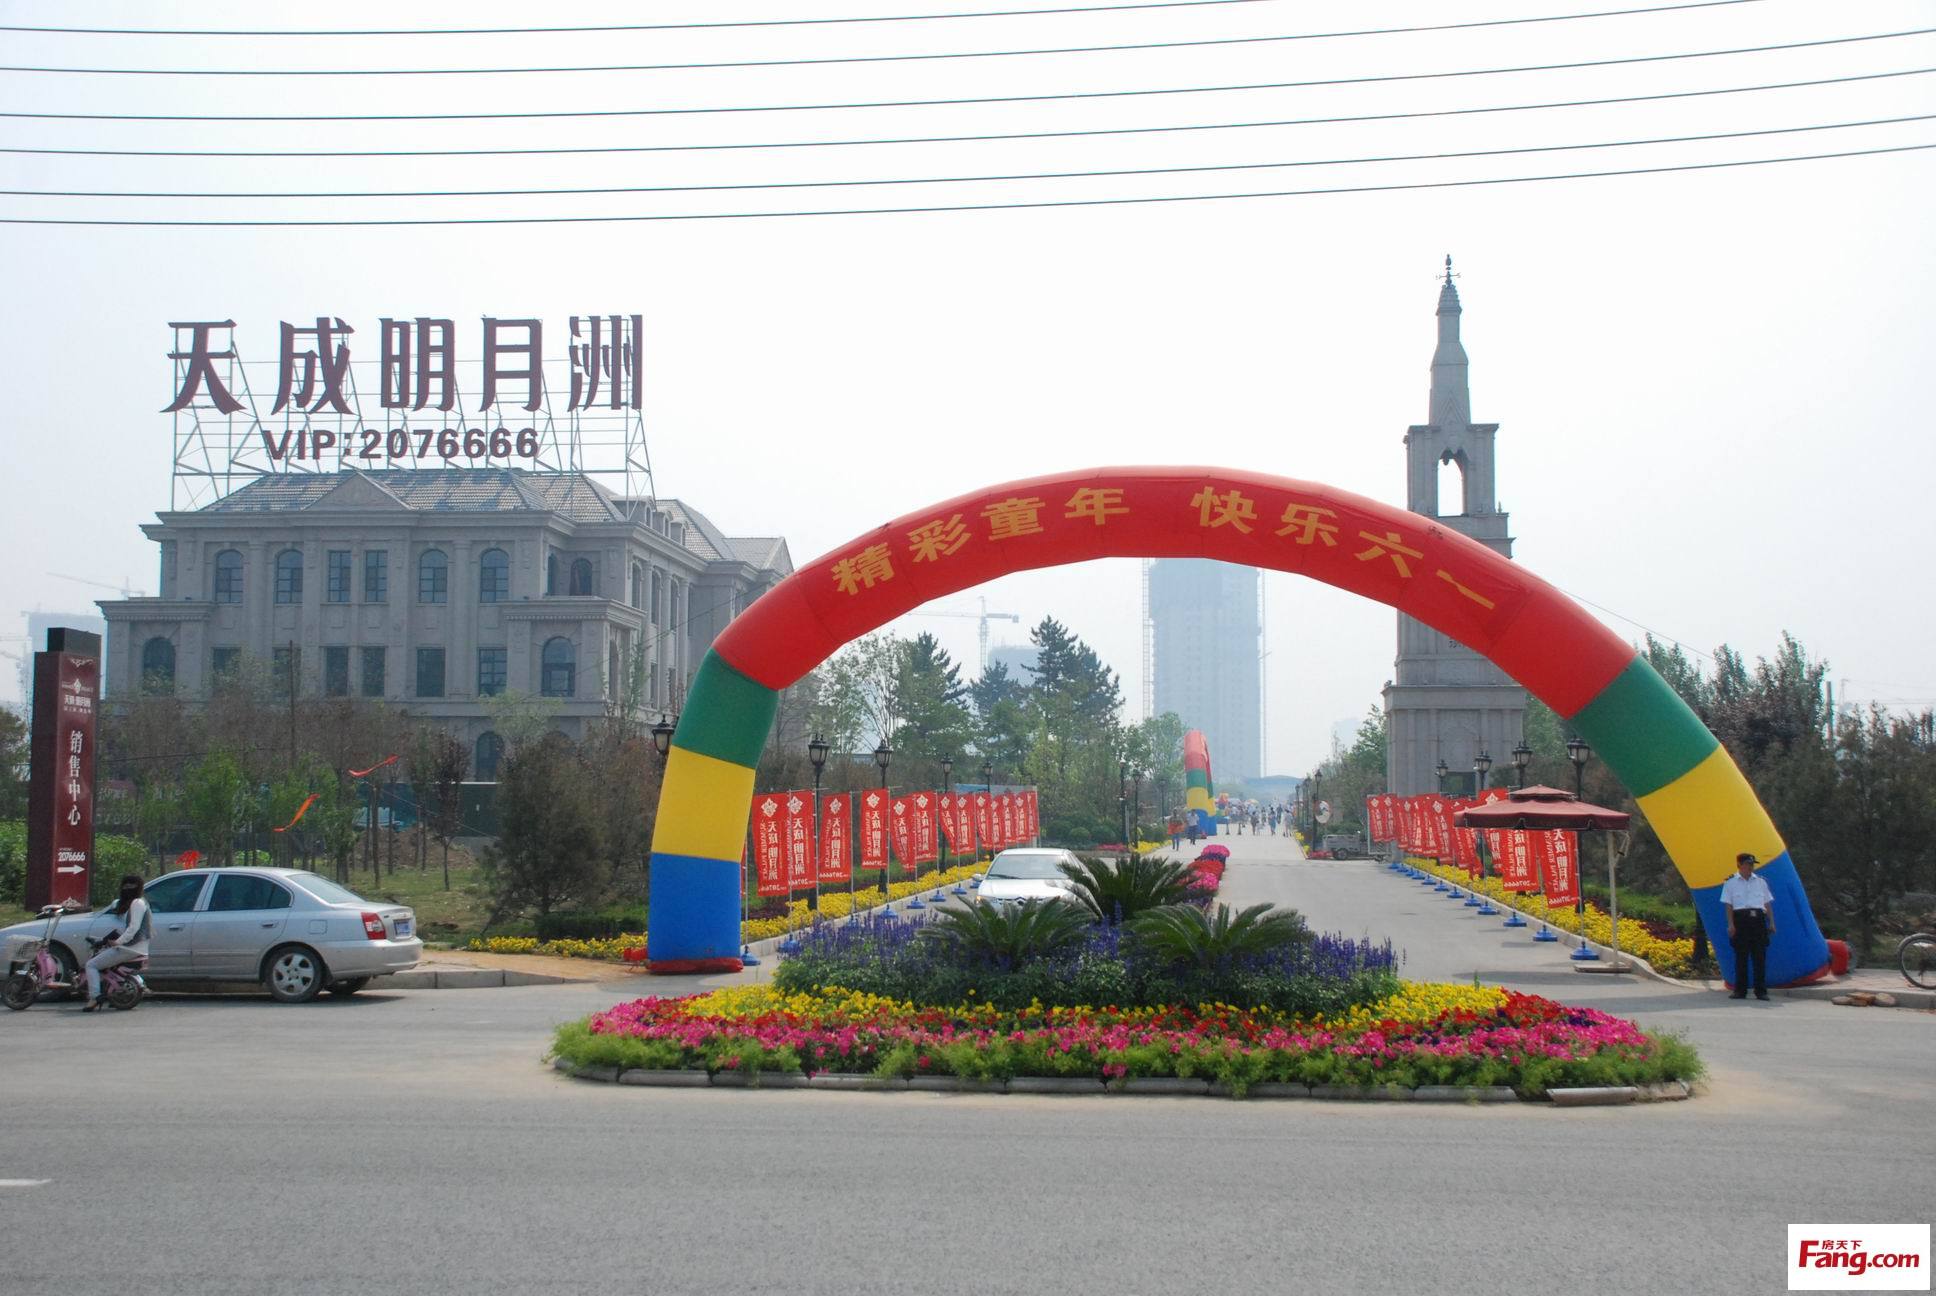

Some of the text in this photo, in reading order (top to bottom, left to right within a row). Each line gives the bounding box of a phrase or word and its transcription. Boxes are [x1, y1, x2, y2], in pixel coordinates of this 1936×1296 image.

[160, 315, 642, 416] 天成明月洲
[264, 428, 539, 460] VIP:2076666
[831, 486, 1496, 610] 精彩童年 快乐六一
[68, 730, 84, 825] 销售中心
[58, 852, 85, 862] 2076666
